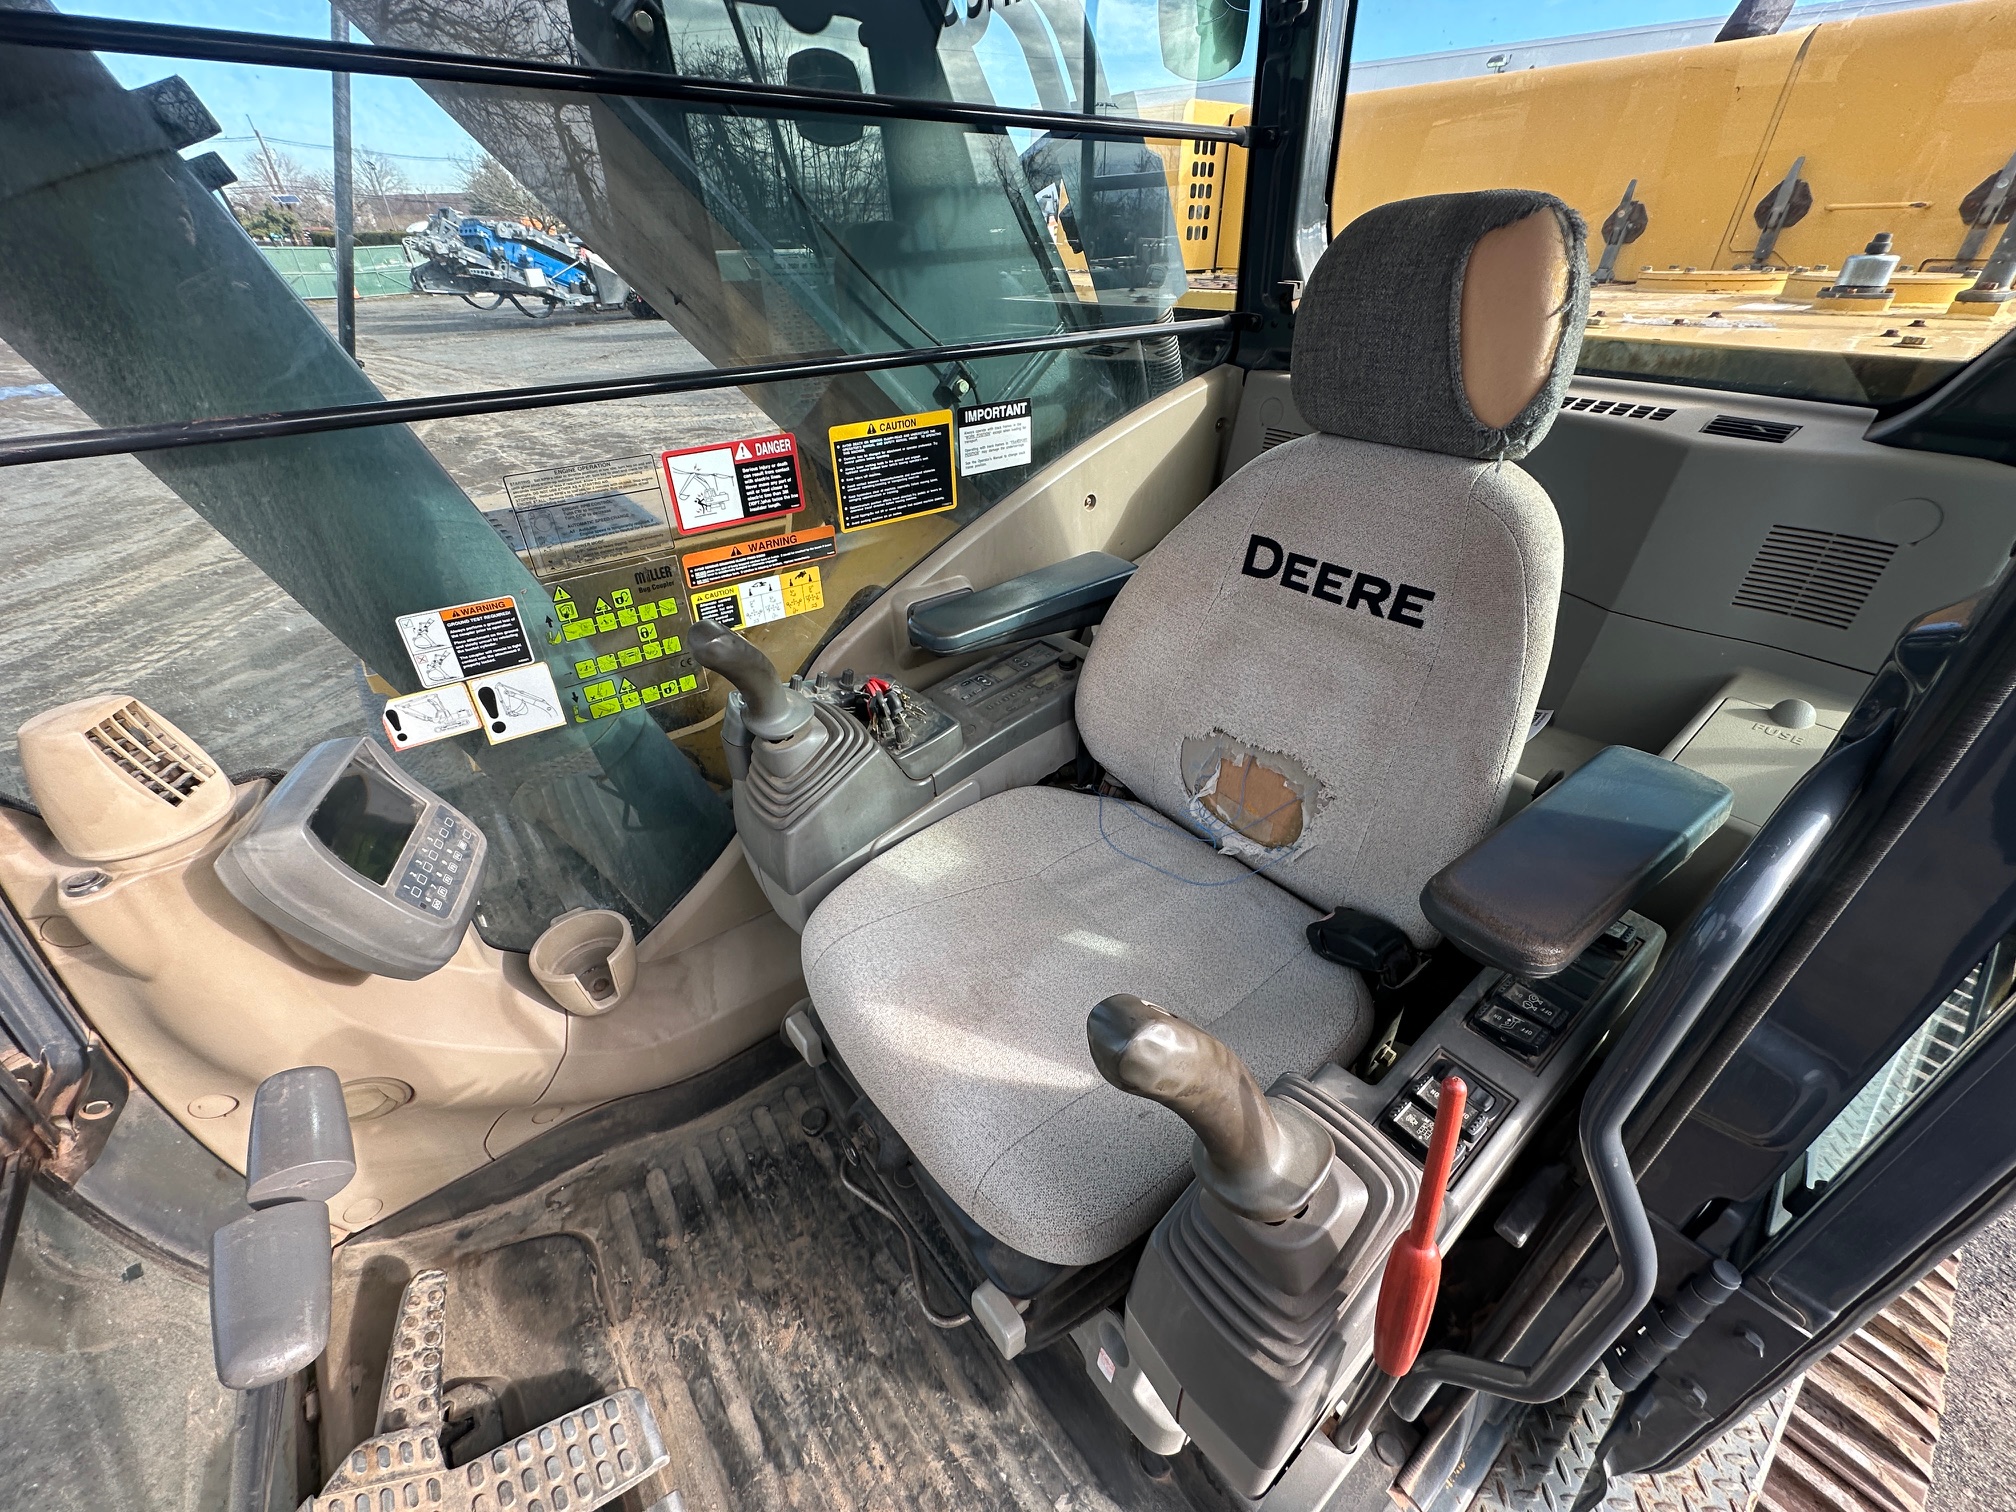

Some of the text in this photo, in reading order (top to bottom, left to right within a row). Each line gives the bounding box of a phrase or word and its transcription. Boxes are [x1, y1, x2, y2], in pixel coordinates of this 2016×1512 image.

[965, 402, 1027, 423] IMPORTANT
[880, 418, 916, 432] CAUTION
[755, 439, 791, 456] DANGER
[577, 462, 611, 471] OPERATION
[748, 535, 797, 552] WARNING
[634, 565, 672, 584] MILLER
[1242, 534, 1435, 629] DEERE
[652, 580, 675, 592] Coupler
[705, 588, 735, 600] CAUTION
[461, 601, 506, 616] WARNING
[447, 619, 470, 627] GROUND
[1752, 723, 1804, 745] FUSE
[1540, 1007, 1553, 1016] OFF
[1520, 1028, 1533, 1036] OFF
